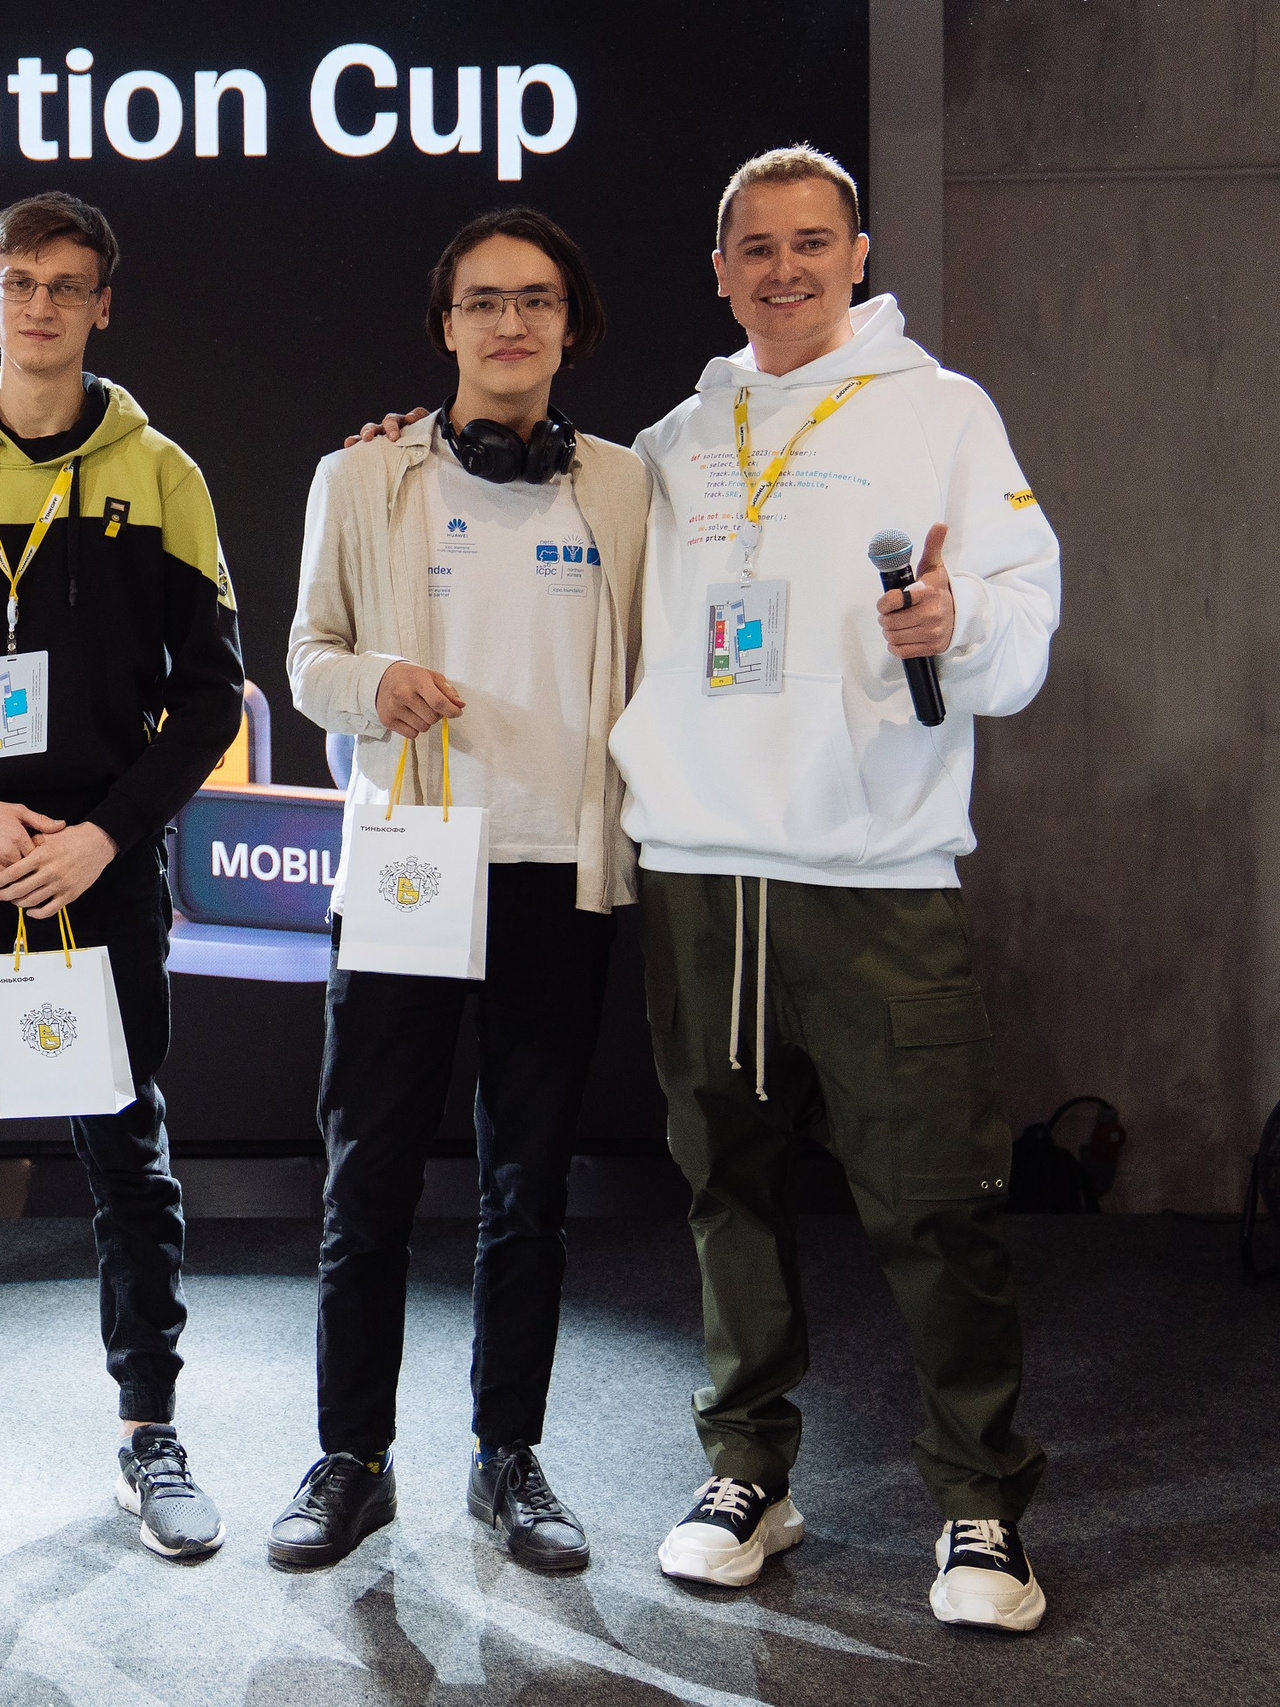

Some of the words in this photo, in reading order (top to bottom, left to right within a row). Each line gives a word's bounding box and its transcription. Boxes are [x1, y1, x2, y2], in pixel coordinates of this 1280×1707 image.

[311, 44, 576, 179] Cup
[774, 481, 829, 489] rack.Mobile,
[44, 497, 58, 521] TINKOFF
[705, 534, 726, 543] prize
[536, 565, 557, 577] icpc
[360, 825, 406, 833] ТИНЬКОФФ
